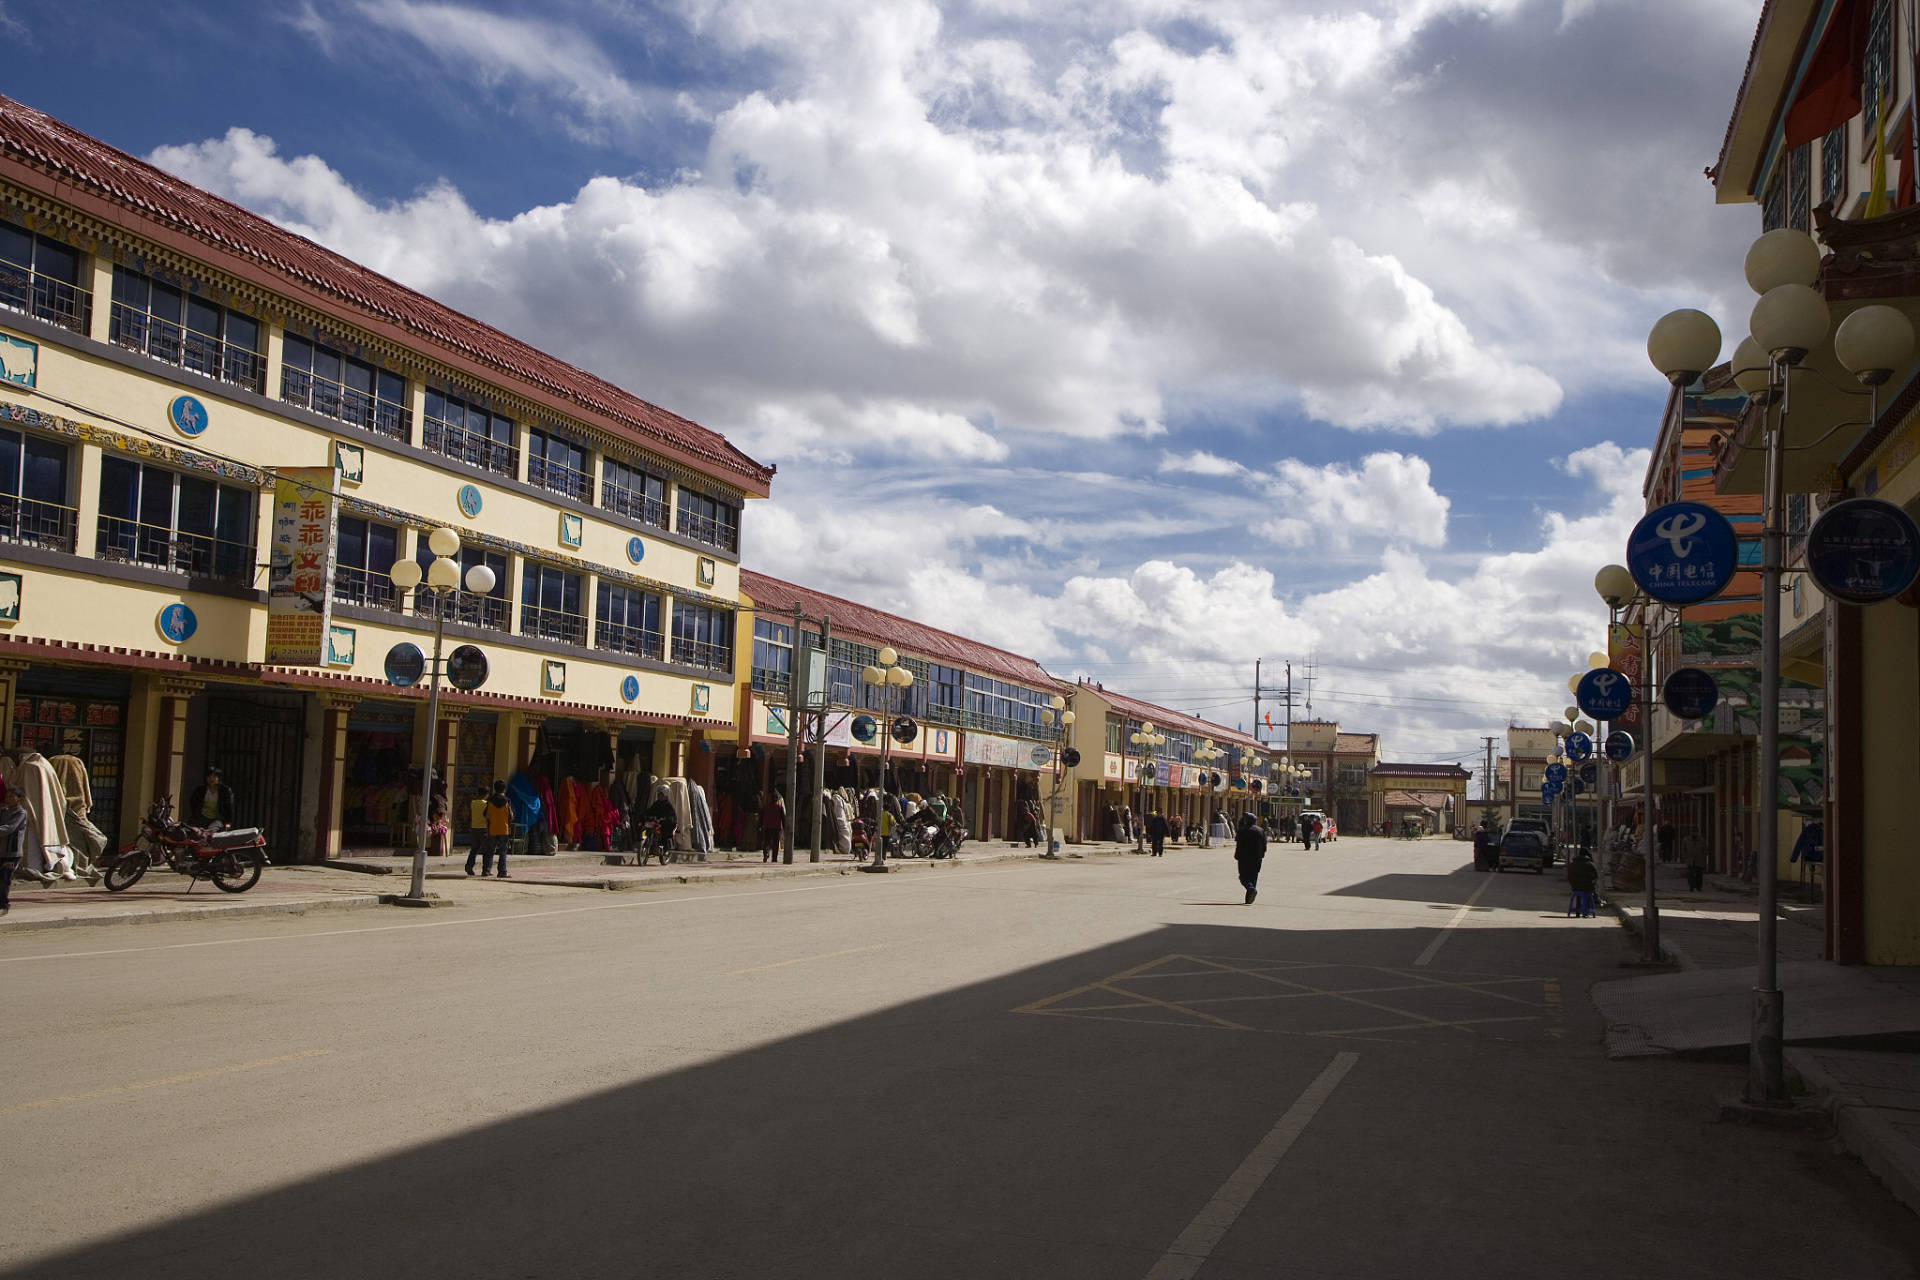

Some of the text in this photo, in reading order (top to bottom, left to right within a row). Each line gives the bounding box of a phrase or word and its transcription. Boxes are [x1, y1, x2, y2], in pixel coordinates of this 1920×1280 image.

[294, 500, 325, 594] 乖乖文印
[1649, 561, 1715, 581] 中国电信
[39, 700, 76, 724] 打字
[87, 703, 120, 725] 复印
